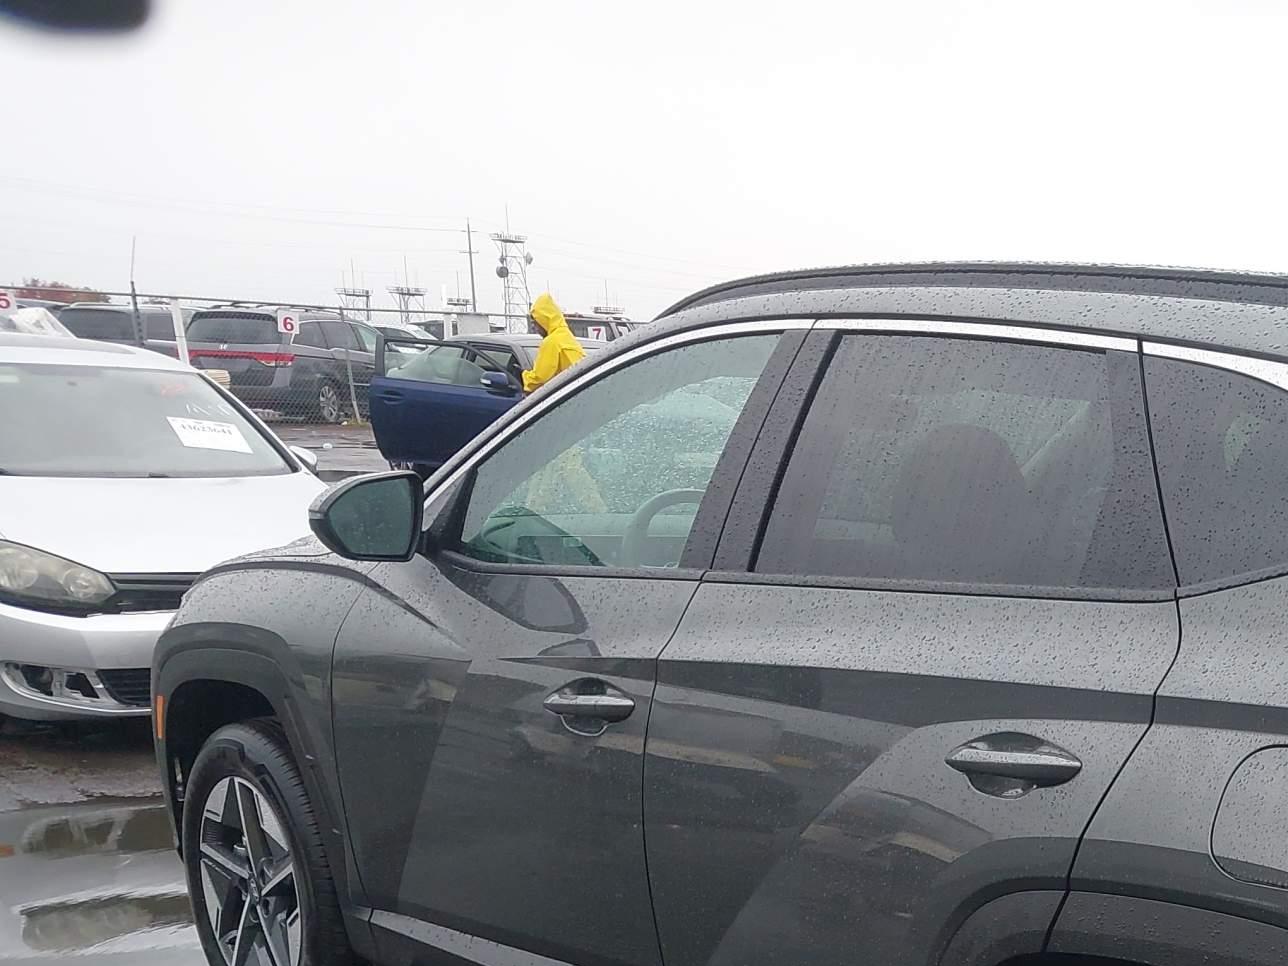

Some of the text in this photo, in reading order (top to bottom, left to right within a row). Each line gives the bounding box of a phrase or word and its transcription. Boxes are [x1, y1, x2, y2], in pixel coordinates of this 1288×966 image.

[0, 292, 10, 309] 5
[283, 316, 295, 331] 6
[592, 328, 602, 340] 7
